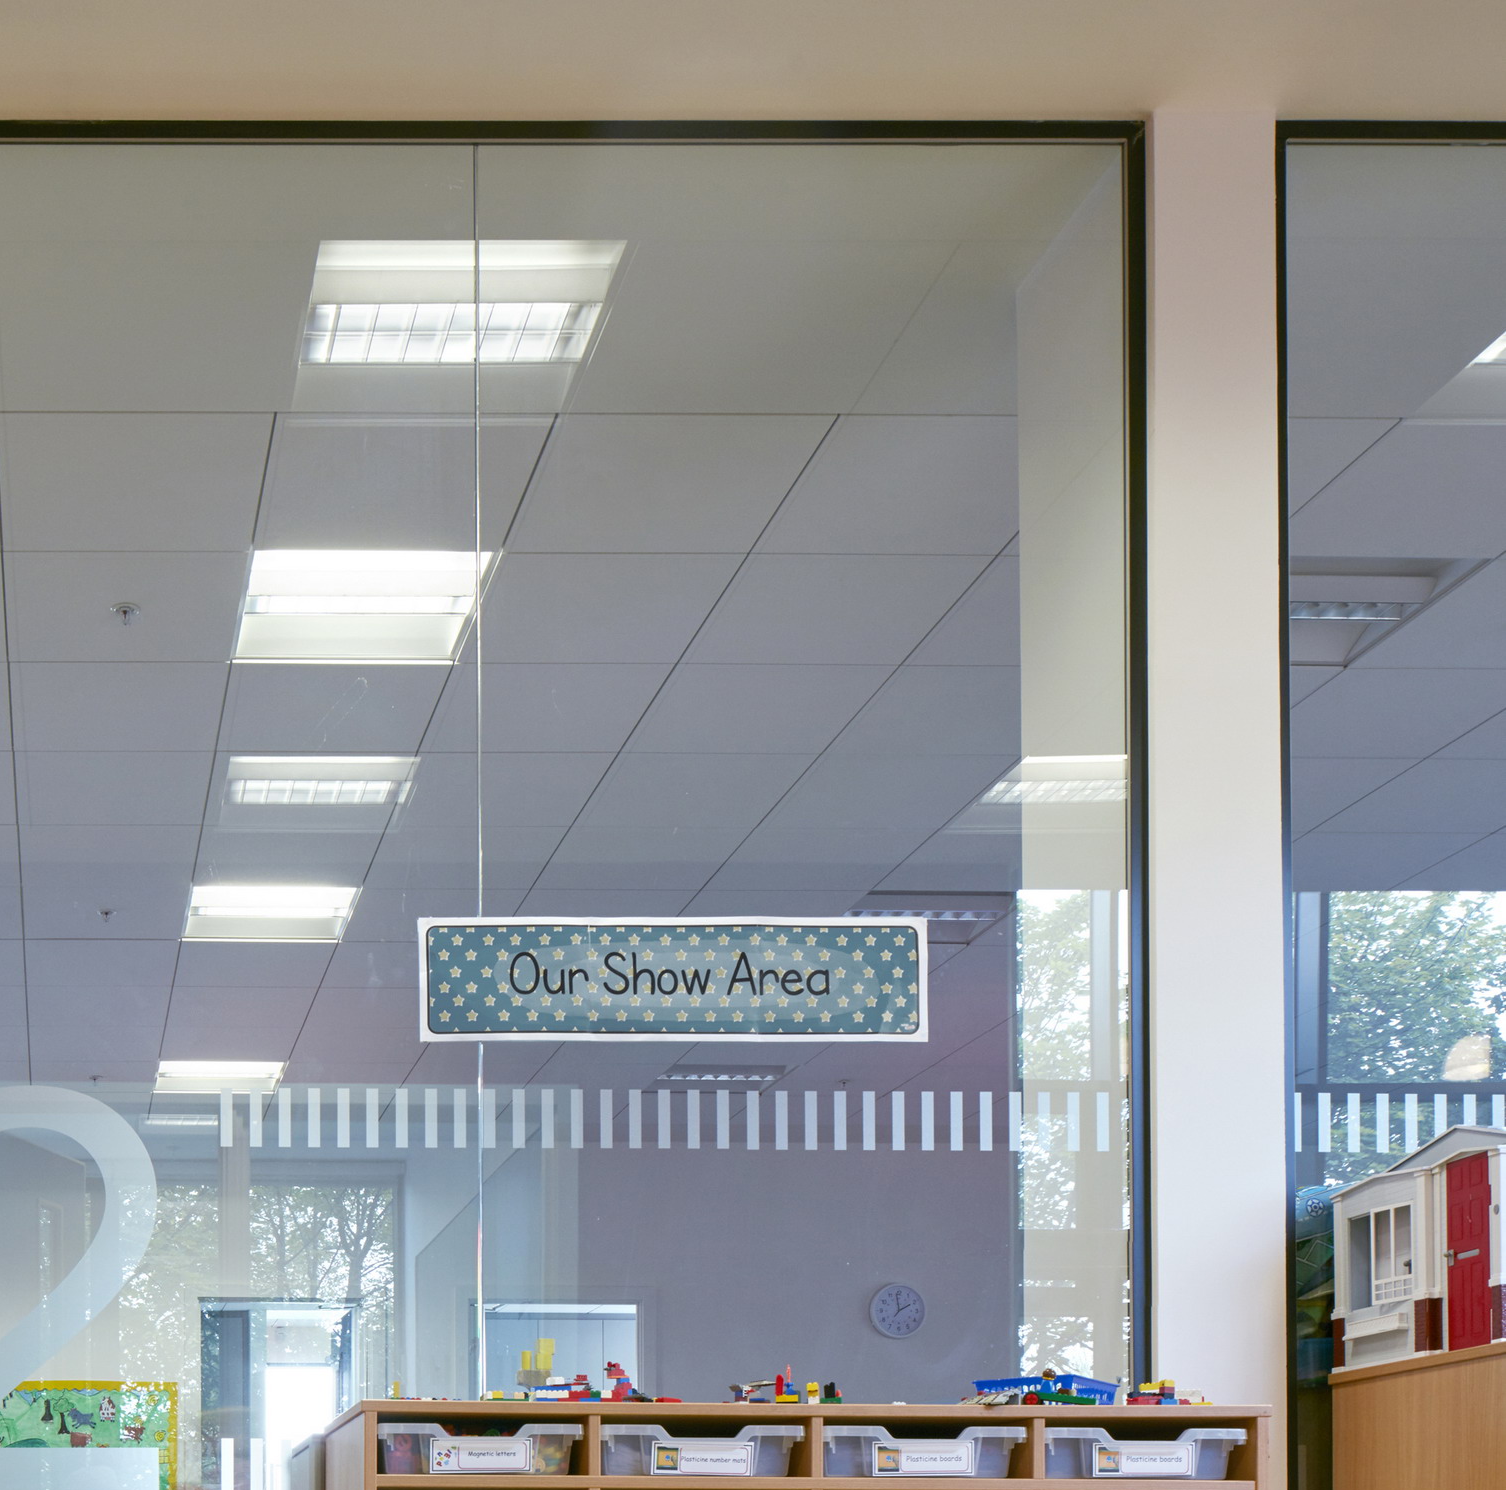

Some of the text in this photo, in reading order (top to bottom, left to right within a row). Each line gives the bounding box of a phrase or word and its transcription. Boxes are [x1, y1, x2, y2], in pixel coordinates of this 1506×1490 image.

[509, 951, 831, 996] Our Show Area
[1126, 1455, 1183, 1463] Plasticine boards
